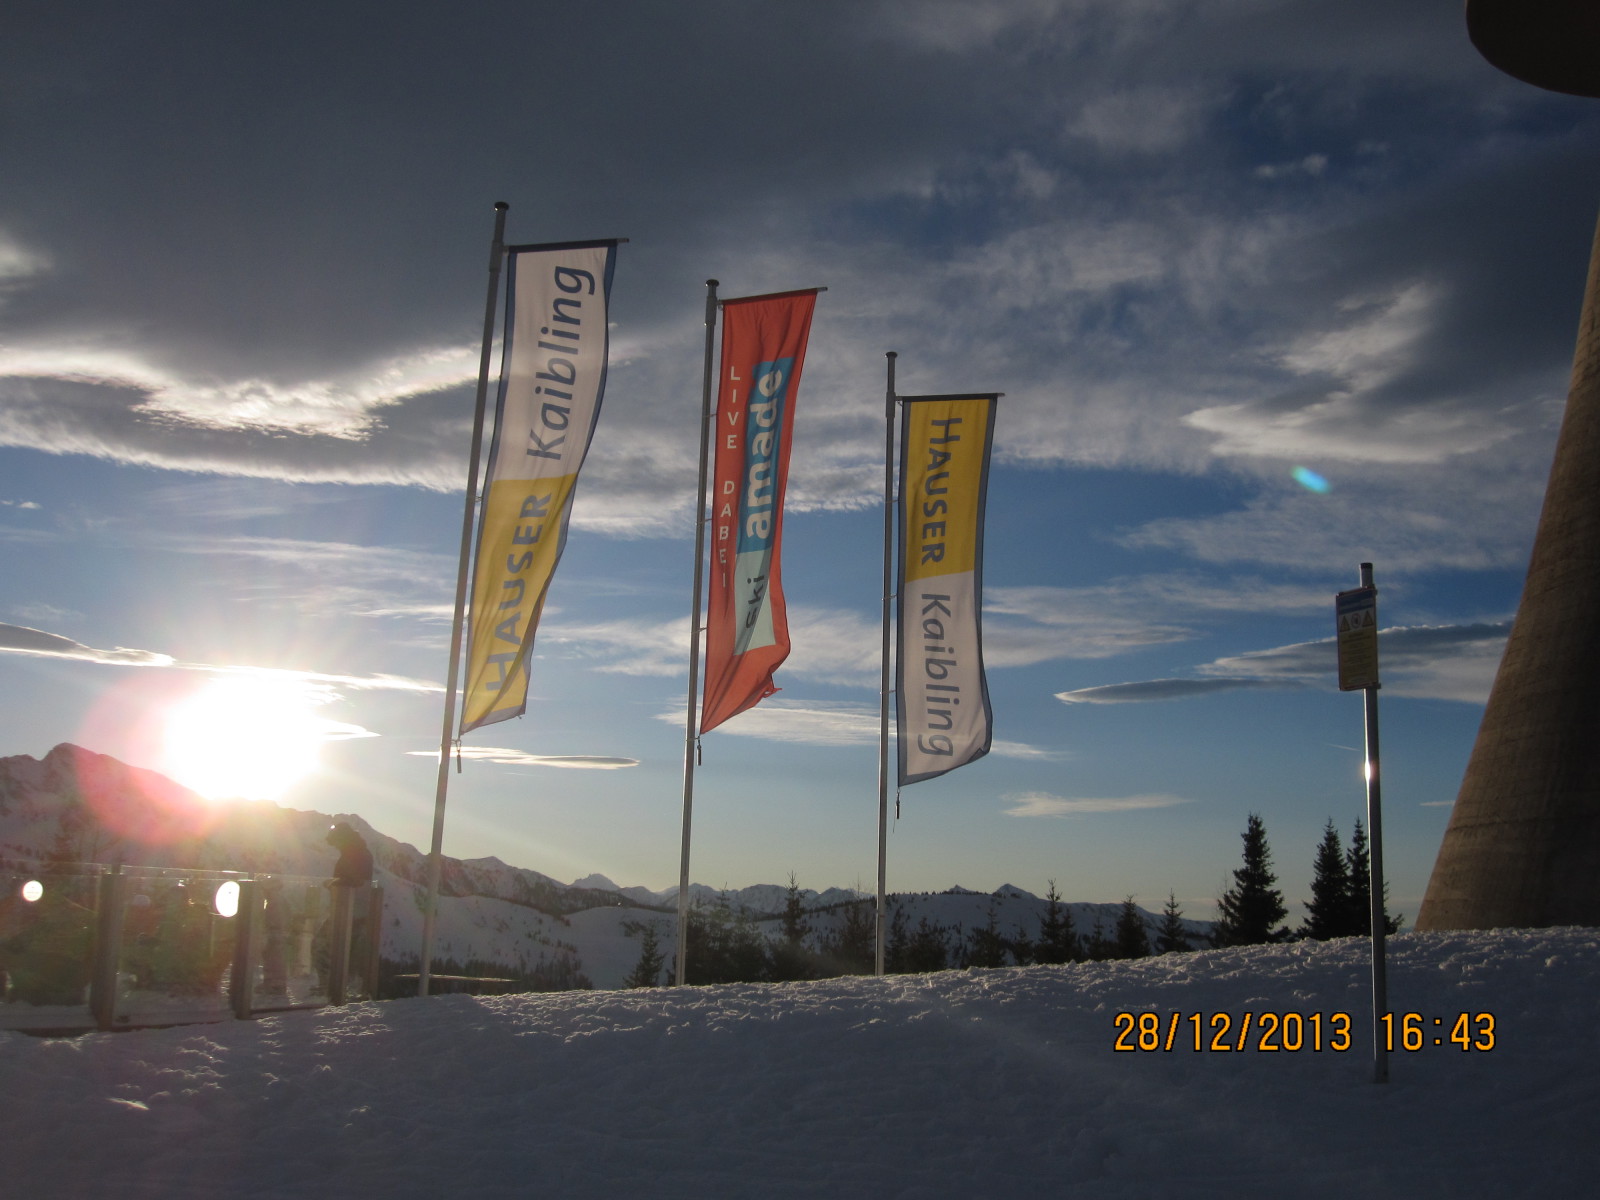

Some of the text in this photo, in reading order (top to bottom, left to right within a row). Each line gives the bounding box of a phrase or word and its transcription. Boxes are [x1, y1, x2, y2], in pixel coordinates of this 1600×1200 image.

[486, 266, 595, 692] HAUSER Kaibling
[719, 366, 741, 588] LIVE DABEI
[917, 417, 962, 757] HAUSER Kaibling
